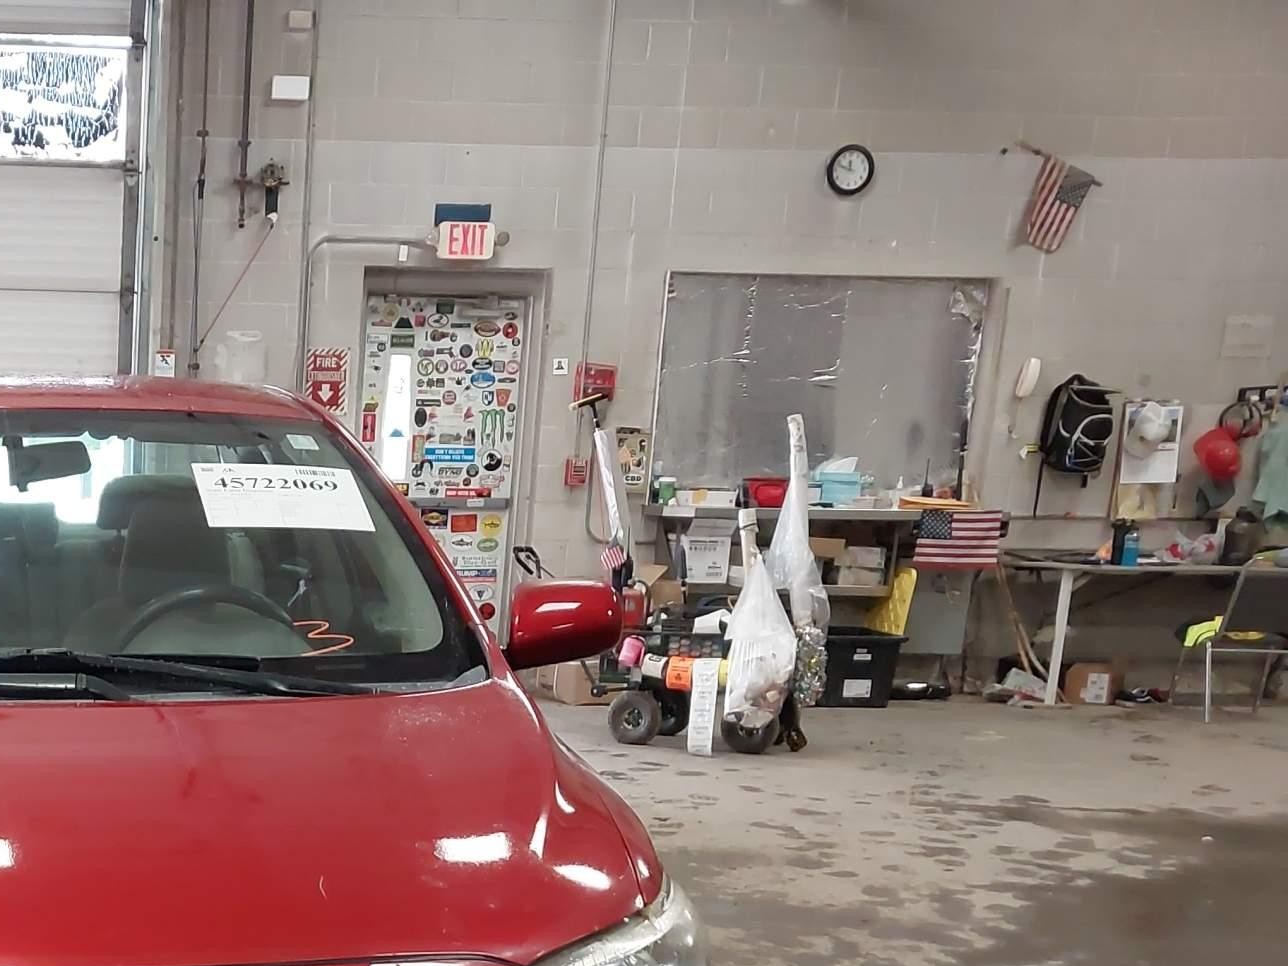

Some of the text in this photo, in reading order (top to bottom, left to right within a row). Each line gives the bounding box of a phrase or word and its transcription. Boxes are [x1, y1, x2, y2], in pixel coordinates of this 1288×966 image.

[448, 224, 488, 256] EXIT
[316, 357, 337, 368] FIRE
[214, 477, 338, 491] 45722069
